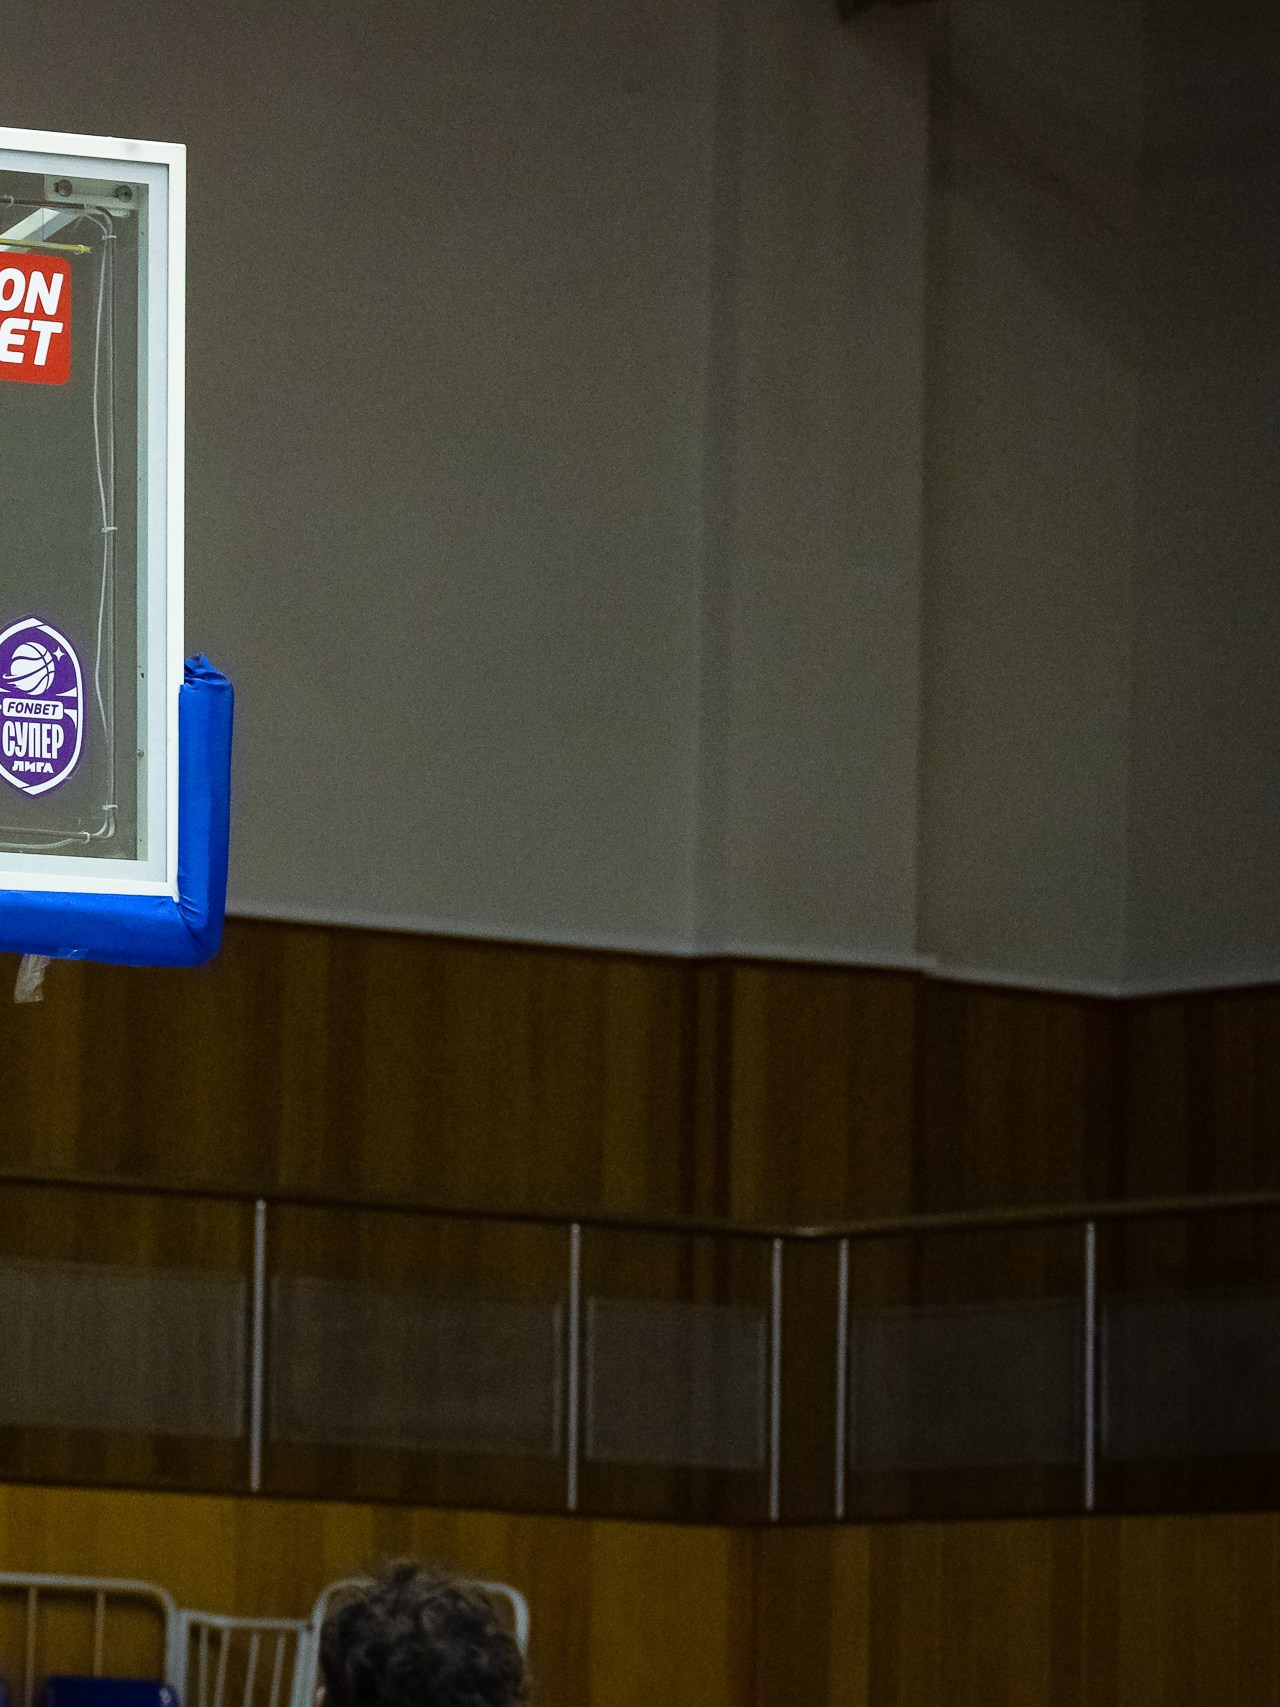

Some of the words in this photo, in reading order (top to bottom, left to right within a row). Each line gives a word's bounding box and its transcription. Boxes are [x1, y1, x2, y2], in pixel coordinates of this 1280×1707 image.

[7, 701, 59, 716] FONBET
[2, 720, 64, 760] СУПЕР
[12, 760, 54, 774] ЛИГА
